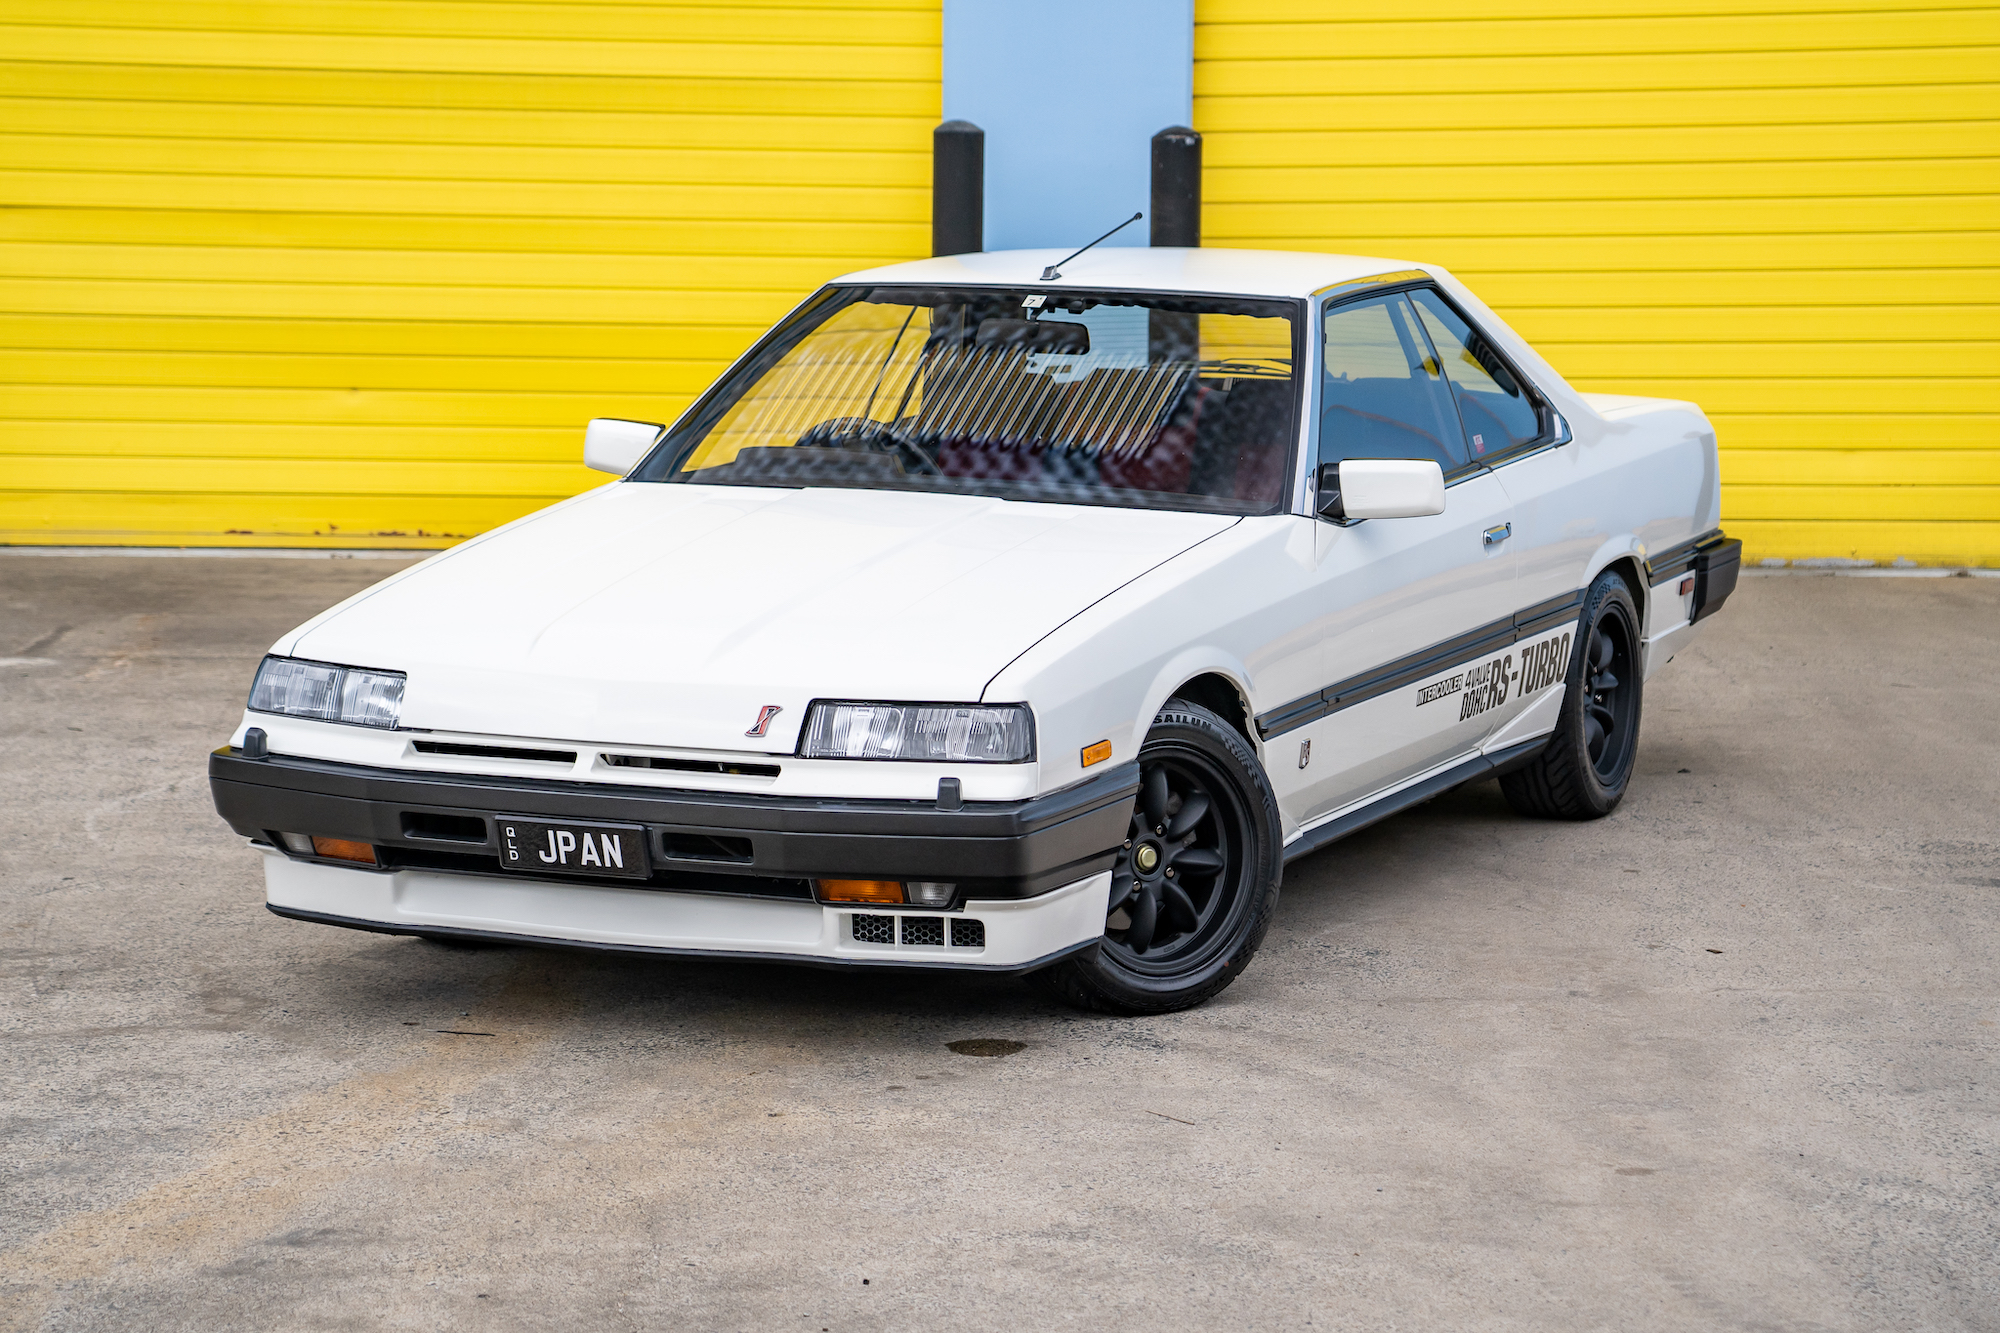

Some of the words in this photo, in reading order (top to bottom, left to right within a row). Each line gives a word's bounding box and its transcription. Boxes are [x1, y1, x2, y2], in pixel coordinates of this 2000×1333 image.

[1416, 673, 1463, 706] INTERCOOLER
[1485, 632, 1570, 711] RS-TURBO
[1459, 684, 1489, 722] DOHC
[1153, 714, 1212, 731] SAILUN
[505, 826, 520, 861] QLD
[538, 829, 624, 869] JPAN
